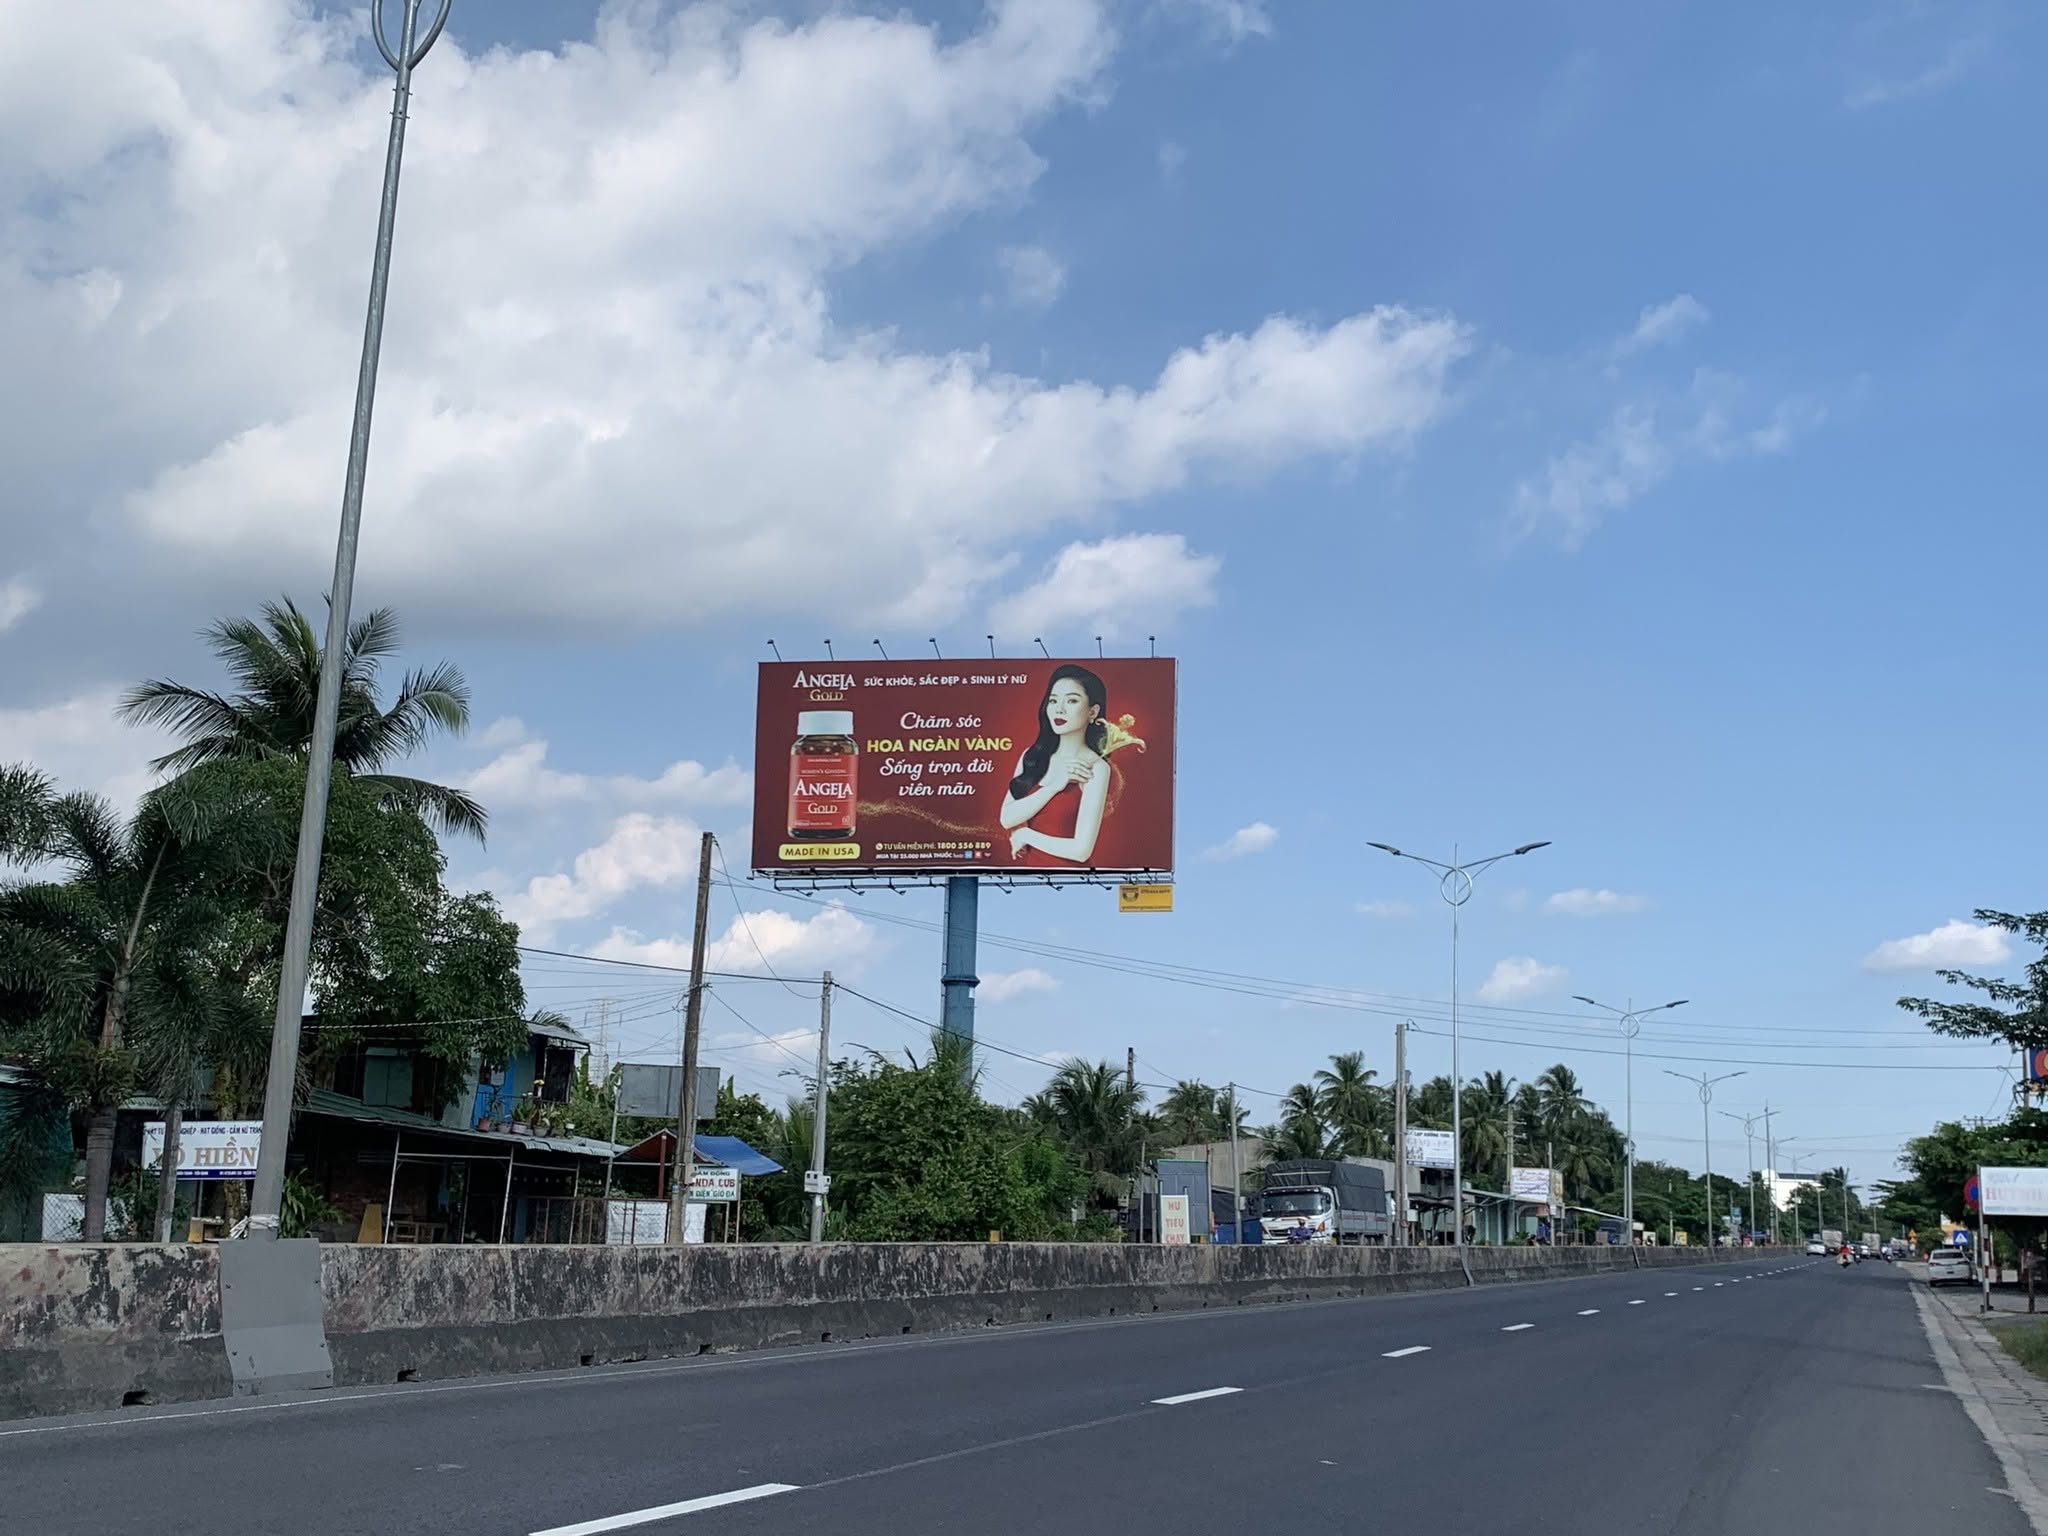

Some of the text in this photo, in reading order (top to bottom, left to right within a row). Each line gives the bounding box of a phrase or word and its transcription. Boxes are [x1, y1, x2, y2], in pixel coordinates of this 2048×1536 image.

[793, 670, 856, 690] ANGELA
[864, 677, 883, 687] SỨC
[919, 673, 939, 686] SẮC
[941, 676, 960, 687] ĐẸP
[971, 675, 995, 684] SINH
[998, 674, 1008, 684] LÝ
[1011, 674, 1028, 684] NỮ
[809, 689, 844, 701] GOLD
[900, 711, 982, 730] Chăm sóc
[867, 735, 1013, 752] HOA NGÀN VÀNG
[880, 757, 994, 781] Sống trọn đời
[793, 778, 854, 799] ANGELA
[899, 782, 976, 796] viên mãn
[807, 803, 838, 814] GOLD
[785, 847, 855, 857] MADE IN USA
[193, 1136, 257, 1167] HIỀN
[718, 1179, 735, 1188] CUB
